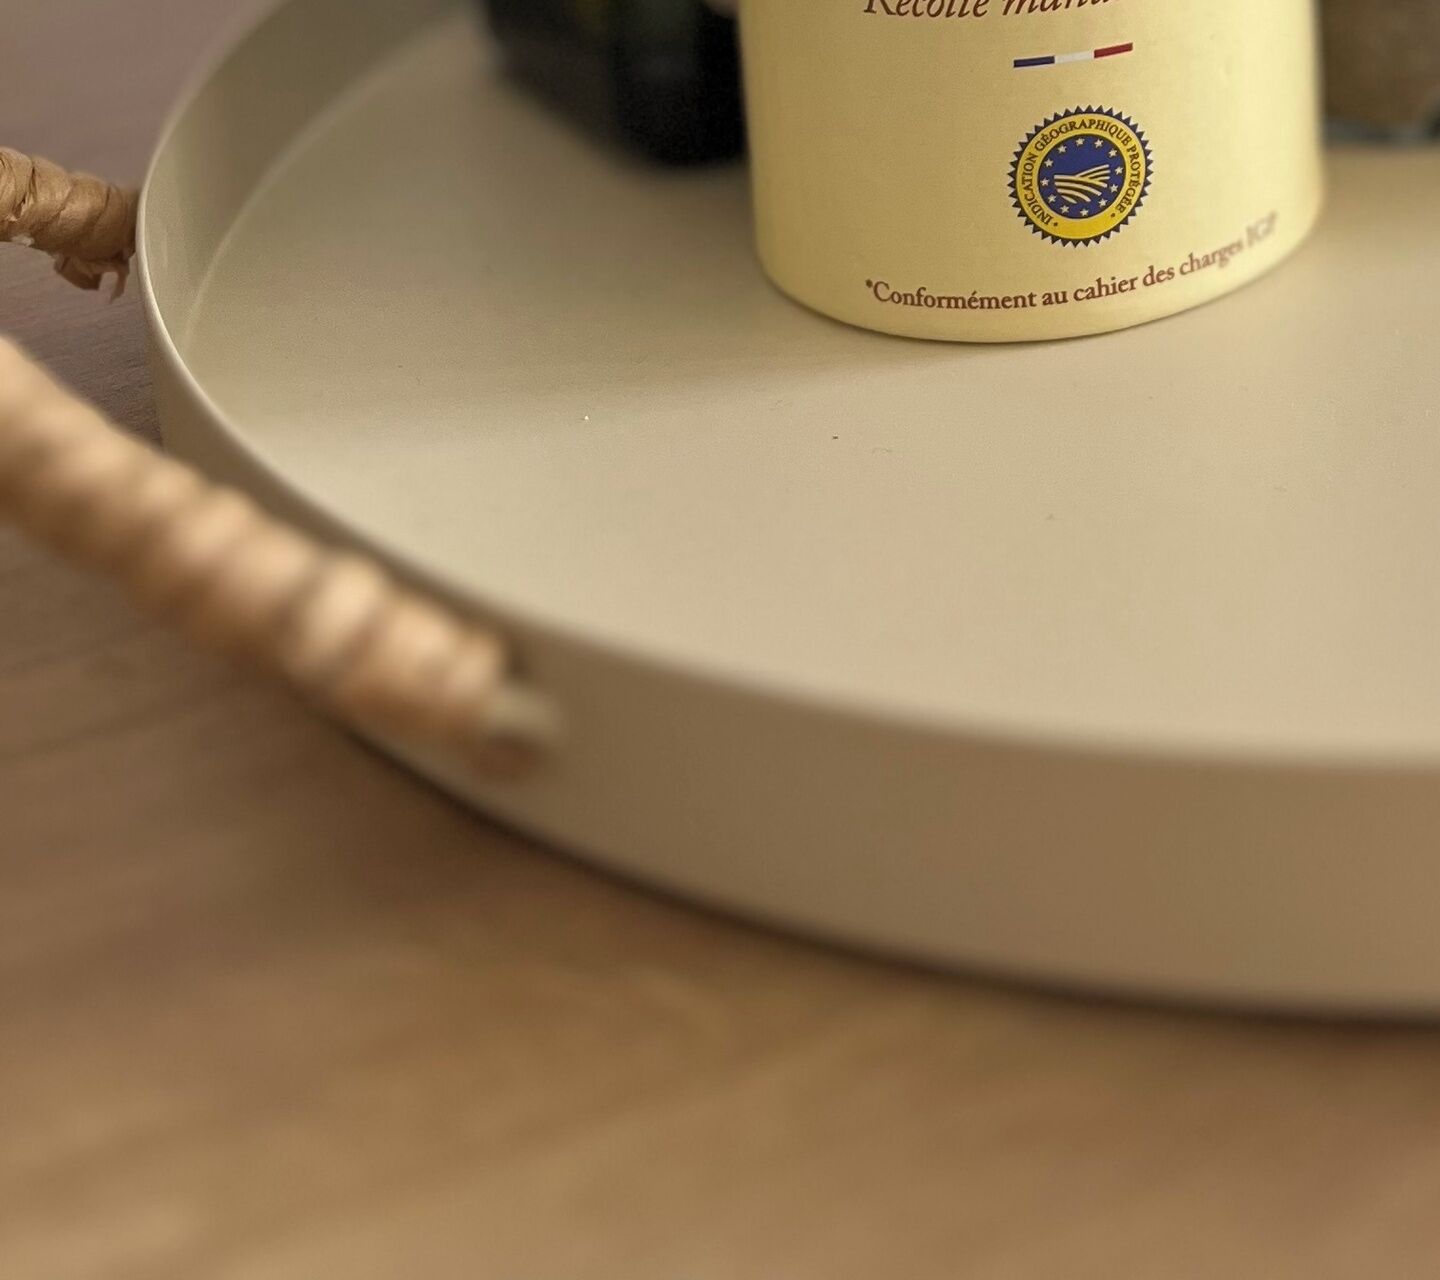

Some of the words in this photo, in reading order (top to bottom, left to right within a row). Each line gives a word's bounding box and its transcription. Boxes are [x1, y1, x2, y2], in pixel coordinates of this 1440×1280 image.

[1035, 118, 1132, 152] GÉOGRAPHIQUE
[1021, 151, 1053, 226] INDICATION
[1115, 144, 1142, 214] PROTÉGÉE
[1041, 290, 1069, 307] au
[1073, 272, 1139, 302] cahier
[1142, 265, 1175, 289] des
[1178, 236, 1243, 277] charges
